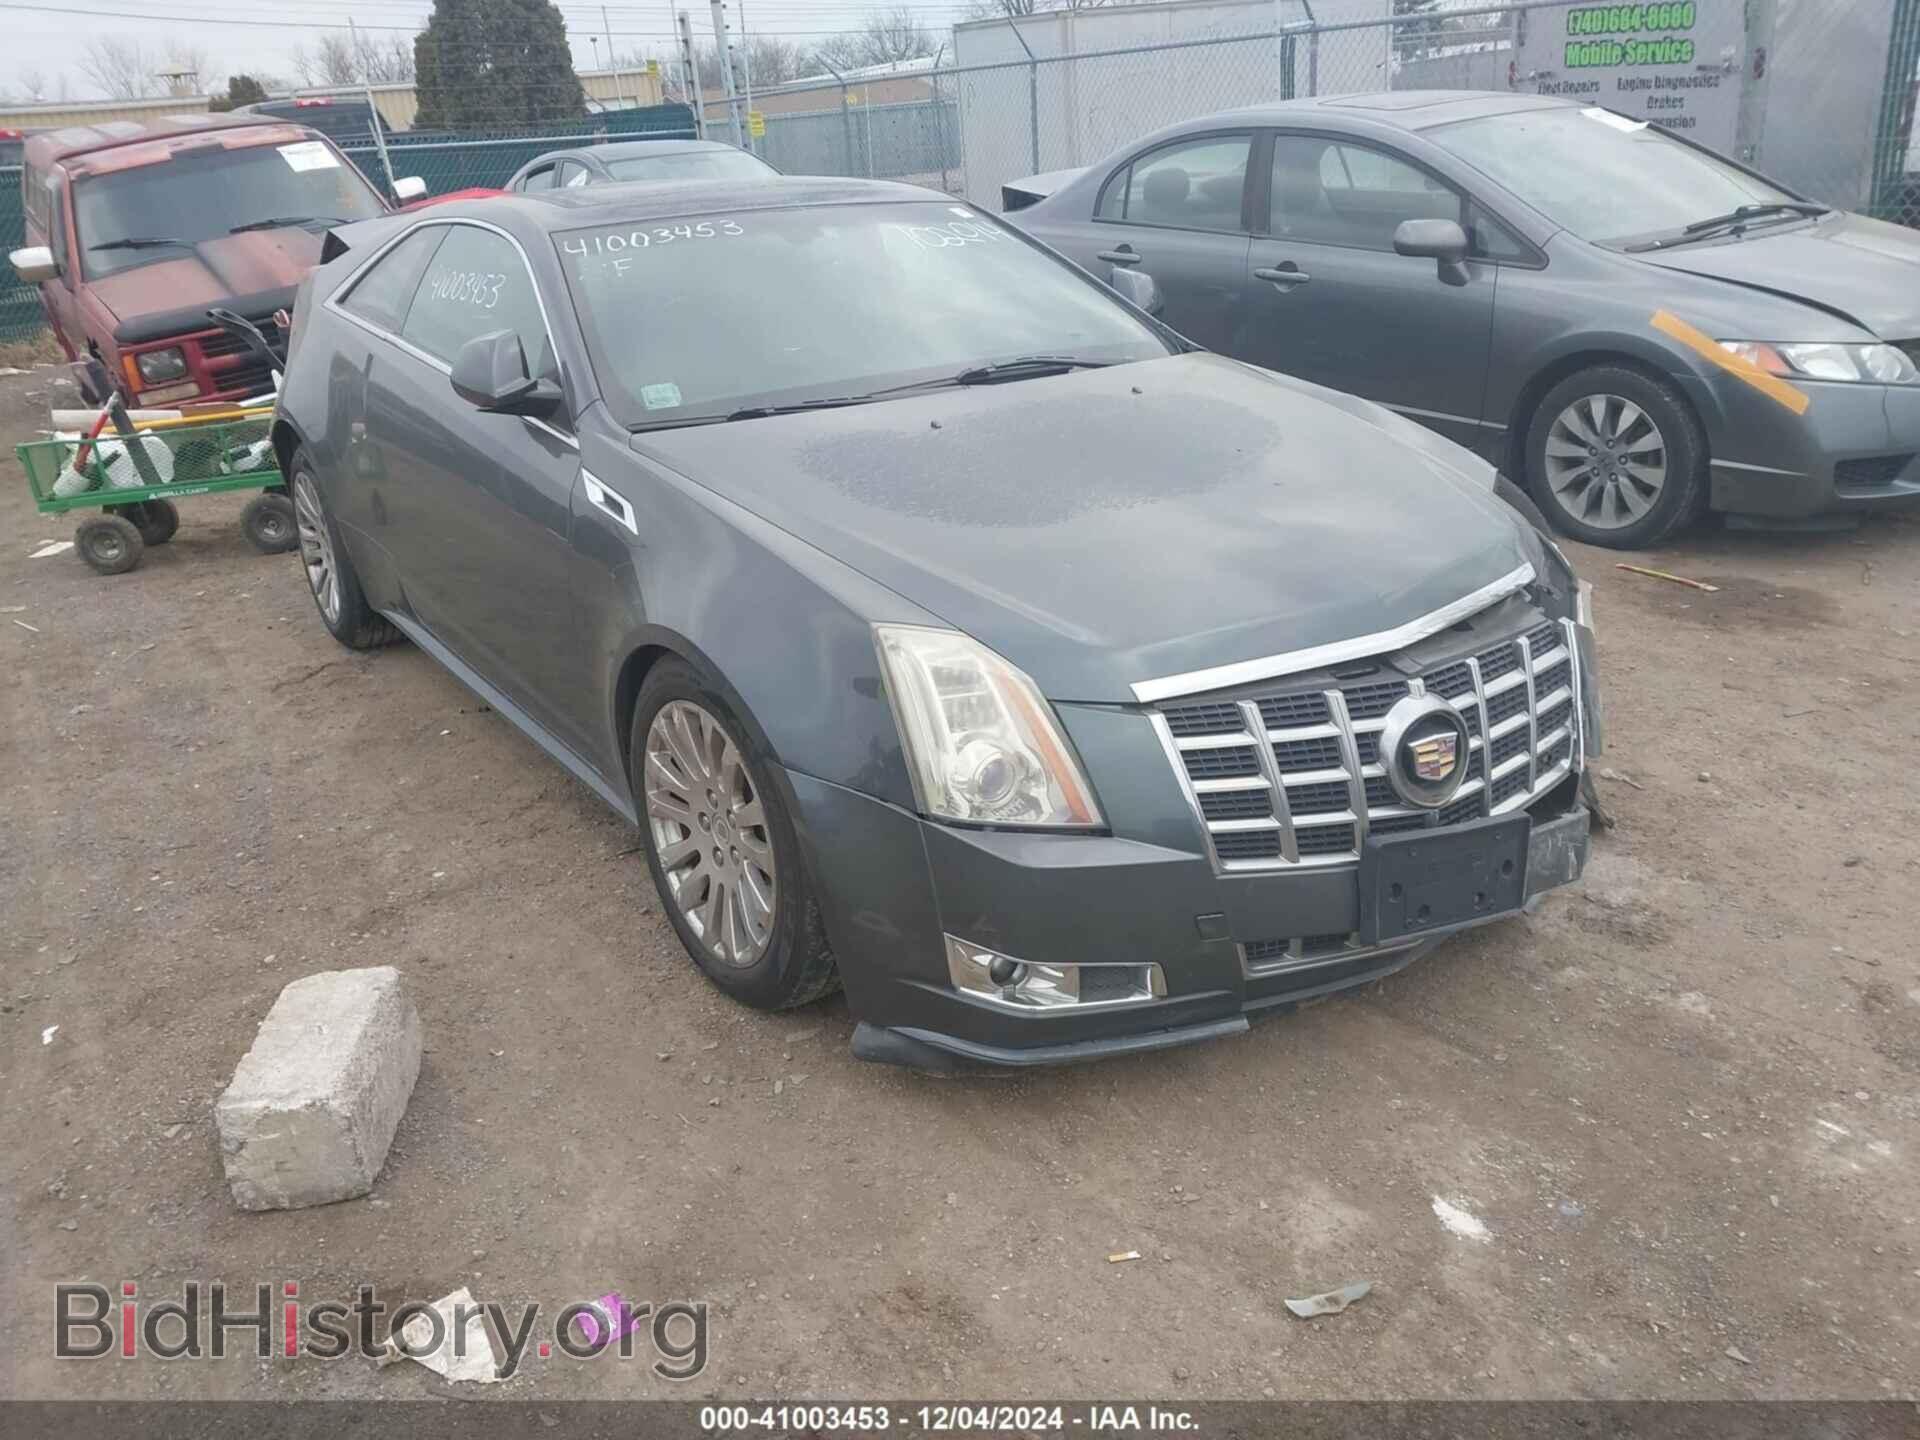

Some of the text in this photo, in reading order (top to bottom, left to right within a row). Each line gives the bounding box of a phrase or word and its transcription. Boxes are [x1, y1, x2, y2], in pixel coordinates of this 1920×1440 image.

[1565, 36, 1694, 68] Mobile Service
[1563, 79, 1600, 94] Repairs
[1617, 74, 1720, 91] Engine Diagnostics
[1646, 95, 1685, 109] Brakes
[564, 220, 744, 257] 41003453
[431, 270, 506, 309] 41003453
